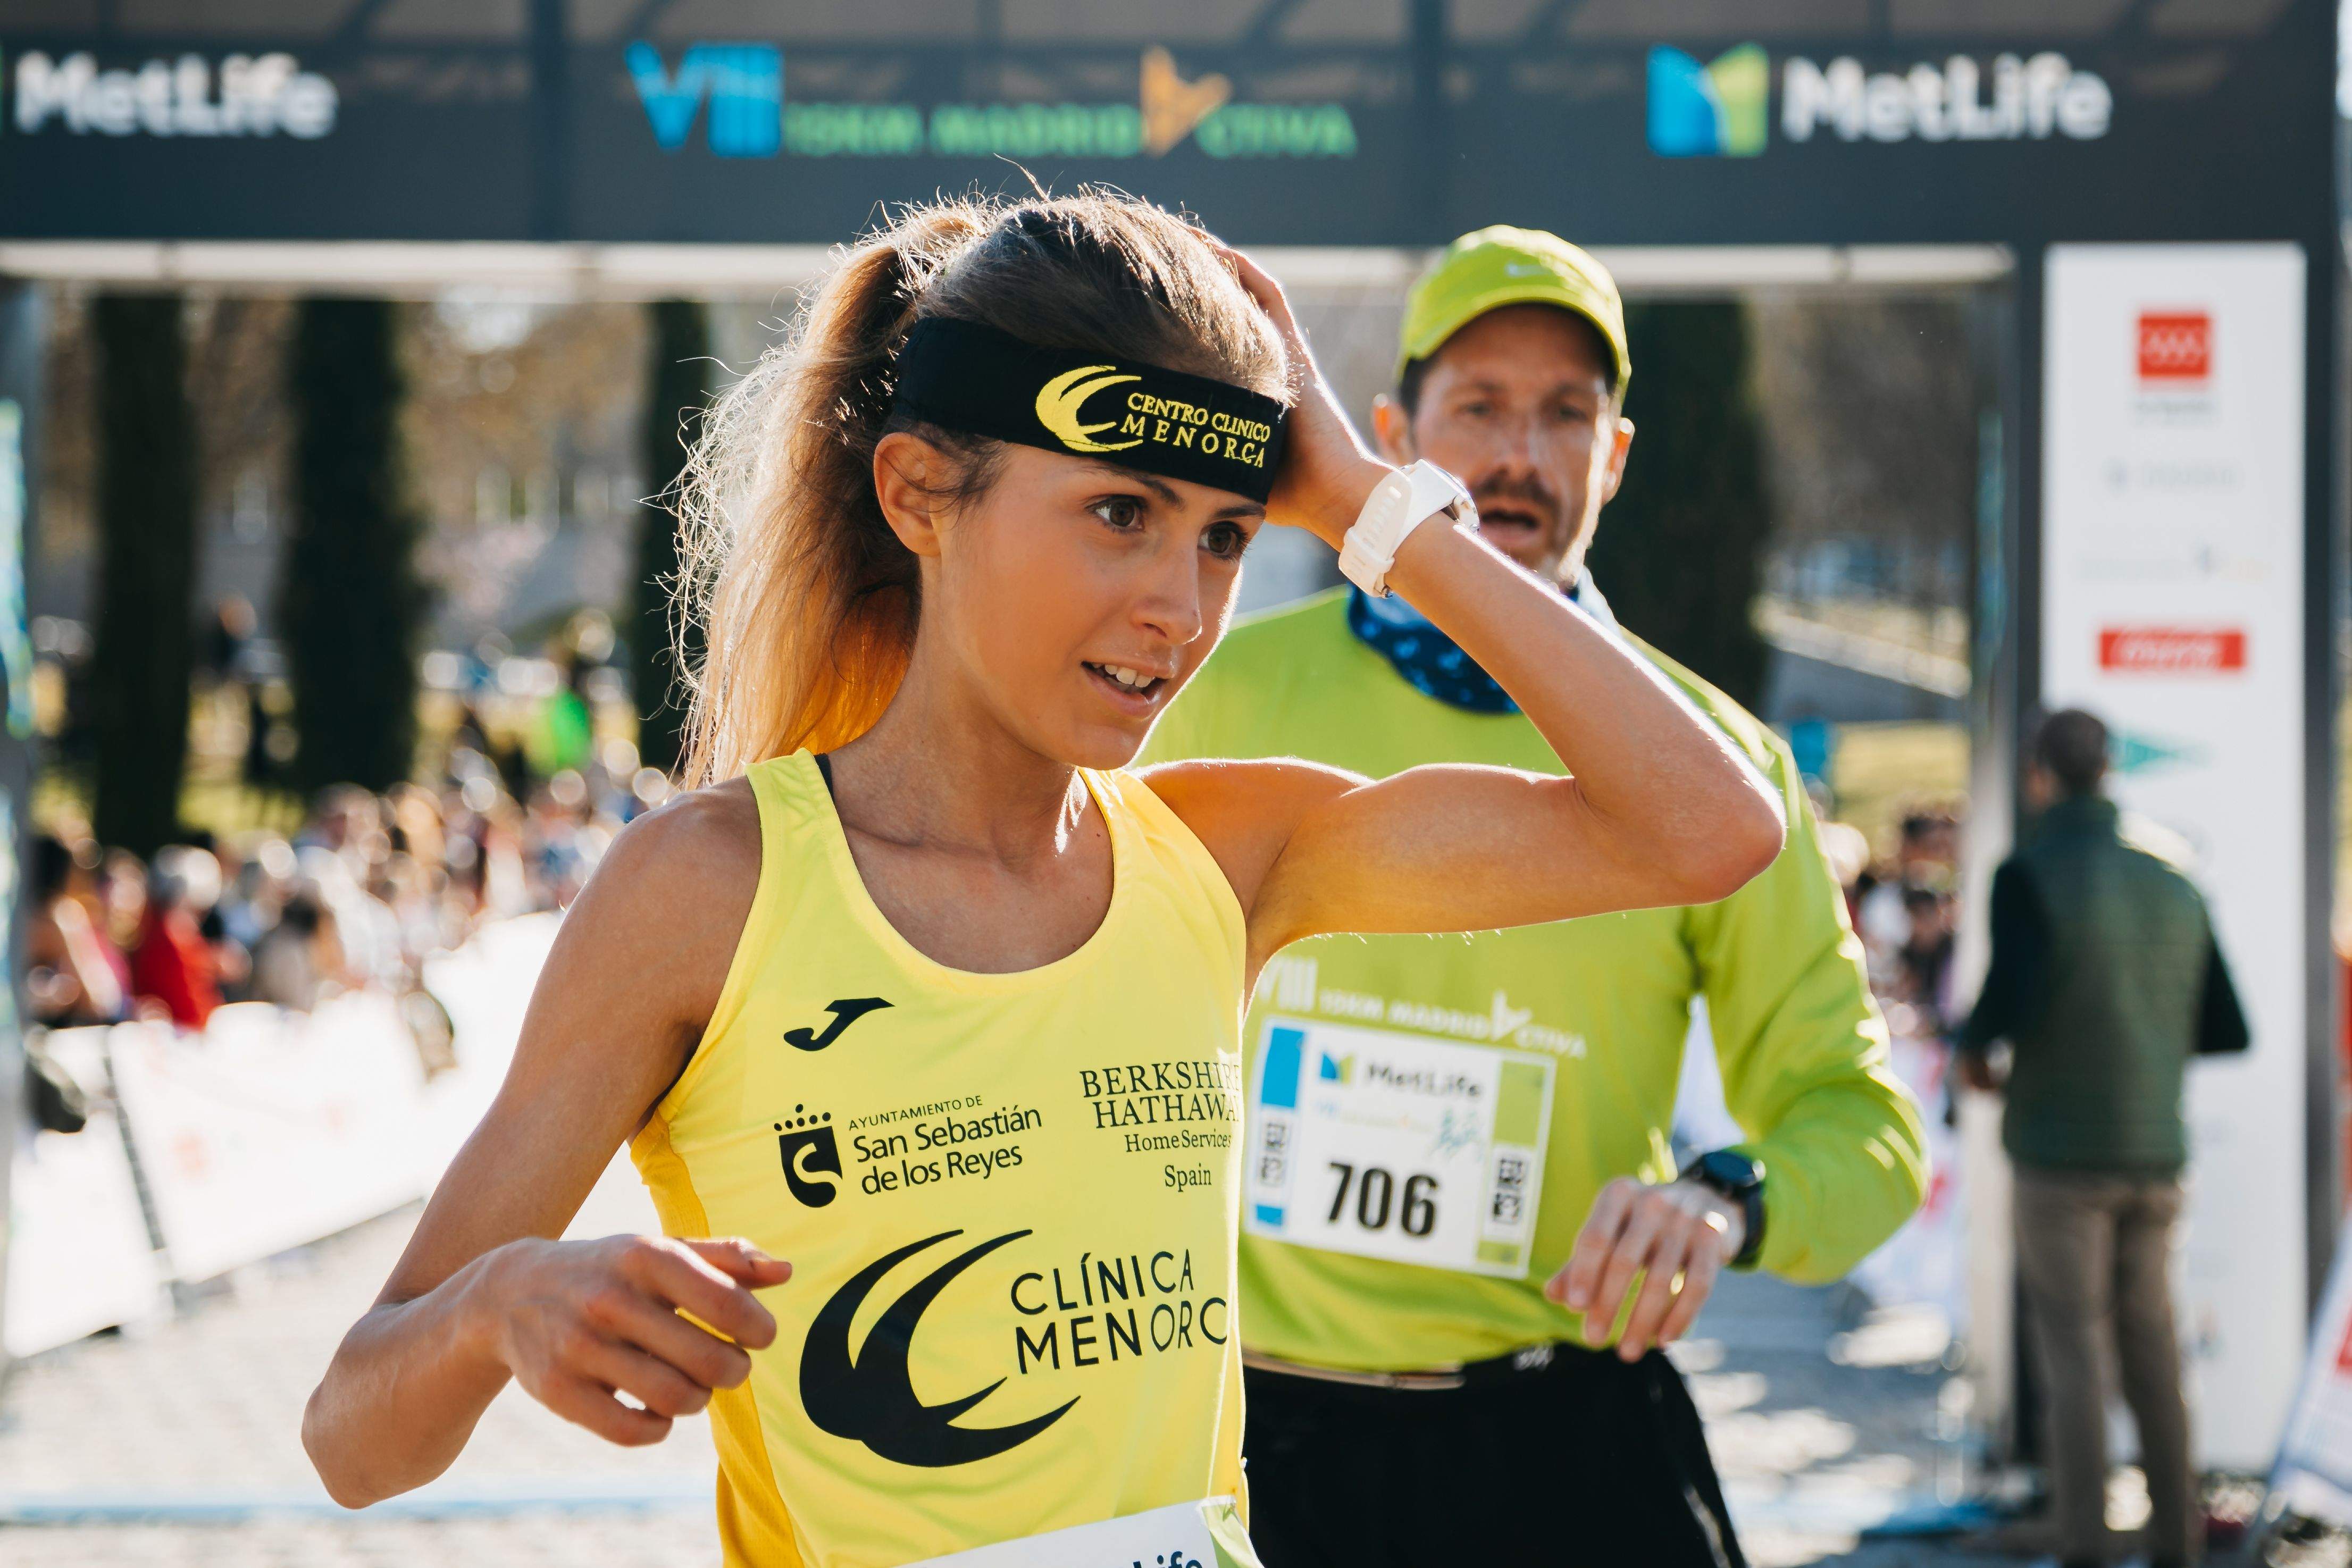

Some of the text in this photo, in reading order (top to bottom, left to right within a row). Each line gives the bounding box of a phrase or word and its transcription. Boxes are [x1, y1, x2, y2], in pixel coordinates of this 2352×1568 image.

[15, 51, 339, 140] MetLife
[1781, 52, 2113, 142] MetLife
[1120, 414, 1265, 468] MENORCA
[1127, 393, 1271, 442] CENTRO CLINICO
[1367, 1061, 1482, 1099] MetLife
[849, 1095, 983, 1131] AYUNTAMIENTO DE
[853, 1105, 1042, 1163] San Sebastián
[861, 1145, 1023, 1195] de los Reyes
[1165, 1163, 1212, 1193] Spain
[1326, 1160, 1439, 1238] 706
[1010, 1248, 1194, 1315] CLÍNICA
[1015, 1297, 1228, 1375] MENORC
